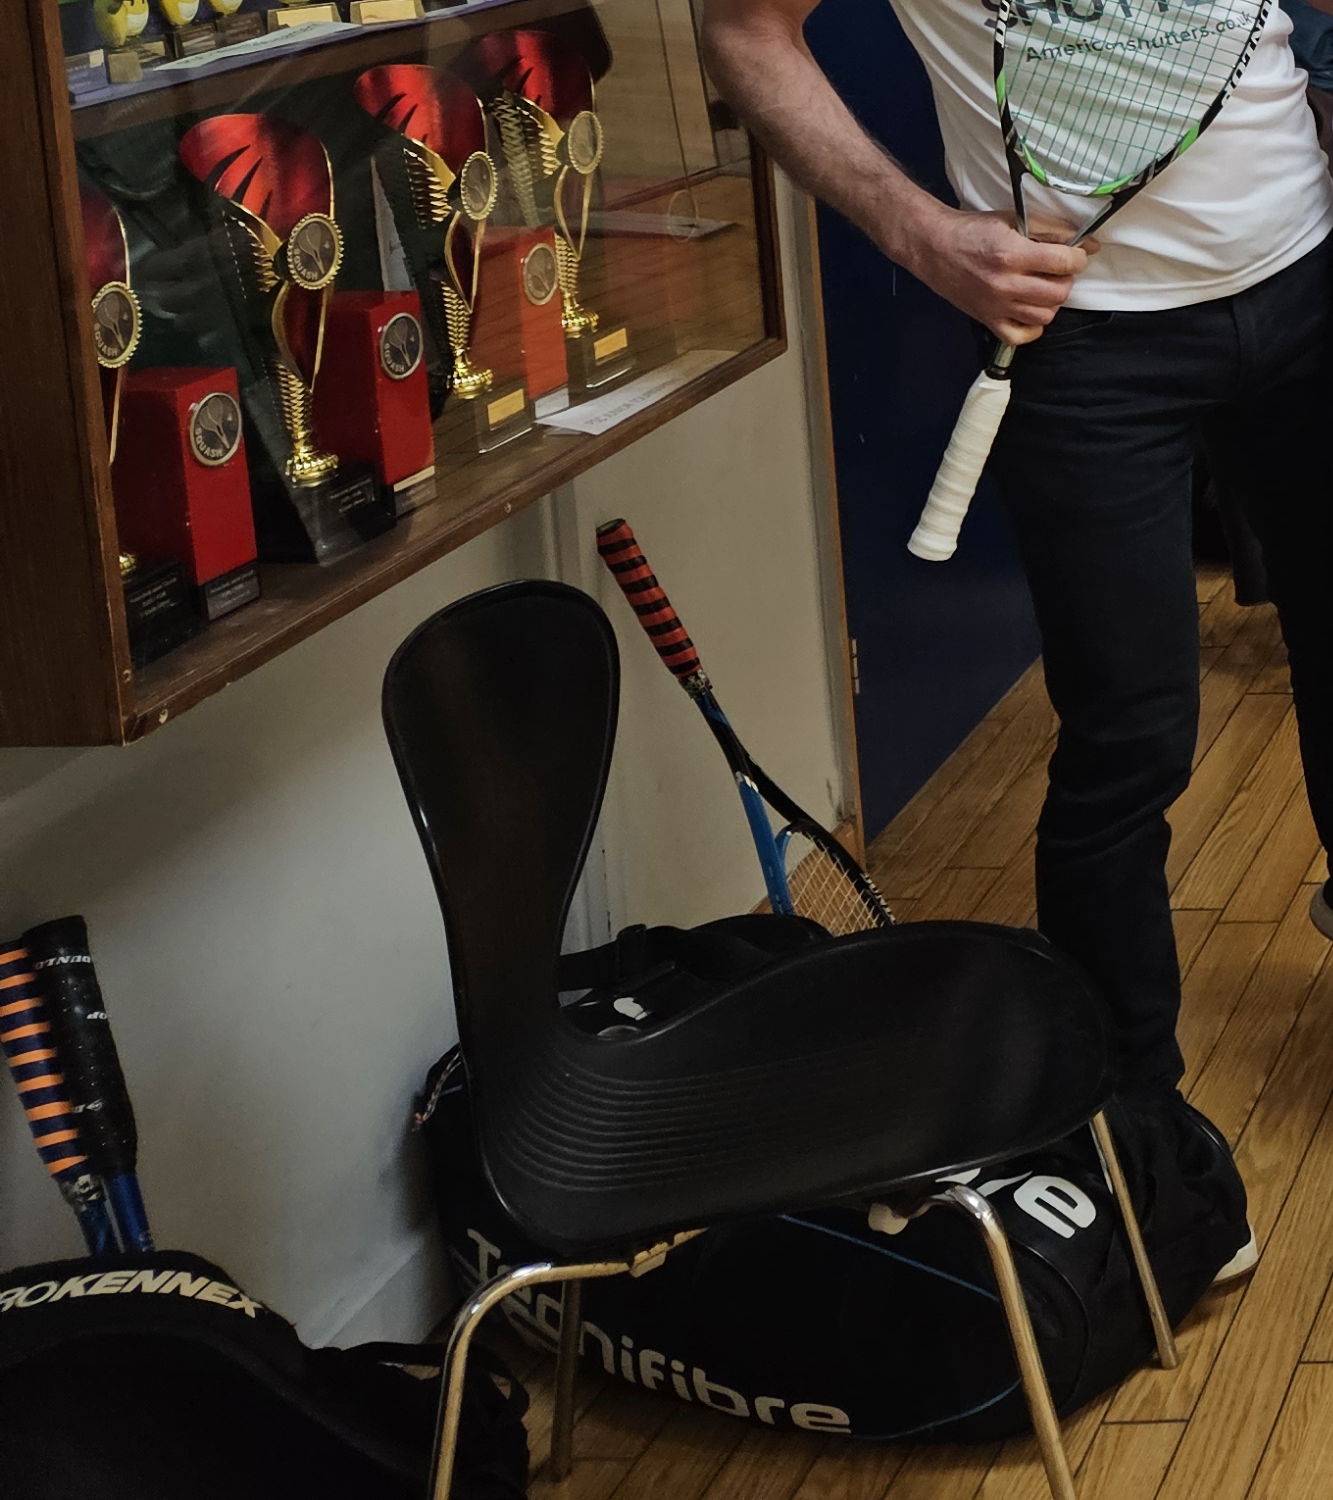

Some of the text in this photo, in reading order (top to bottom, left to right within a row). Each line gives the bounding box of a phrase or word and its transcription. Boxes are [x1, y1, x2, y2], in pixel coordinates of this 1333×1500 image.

[293, 248, 319, 281] SQUASH
[193, 426, 225, 458] SQUASH
[34, 955, 91, 971] DUNLO
[0, 1269, 264, 1319] ROKENNEX
[467, 1228, 852, 1434] Tcnifibre
